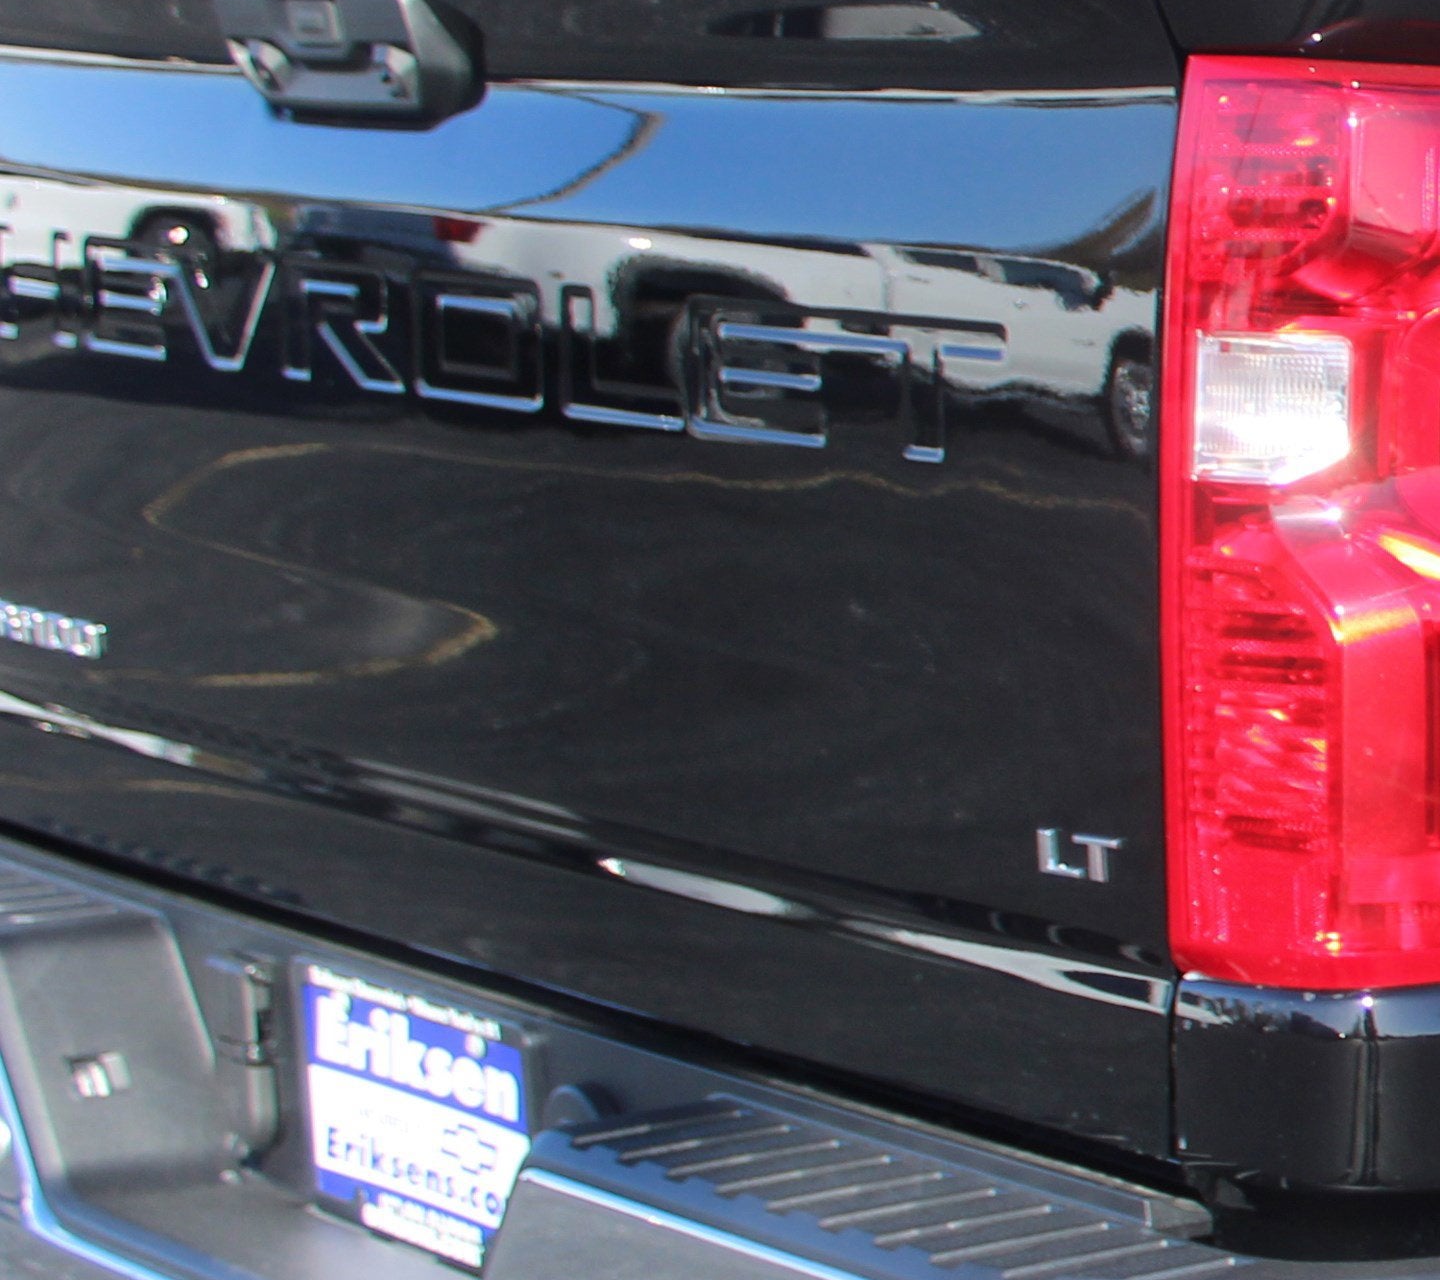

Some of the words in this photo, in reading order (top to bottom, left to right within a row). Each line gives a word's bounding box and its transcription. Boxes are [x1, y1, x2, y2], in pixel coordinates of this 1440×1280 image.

[1036, 828, 1123, 883] LT
[314, 992, 520, 1122] Eriksen
[327, 1124, 503, 1218] Eriksens.co
